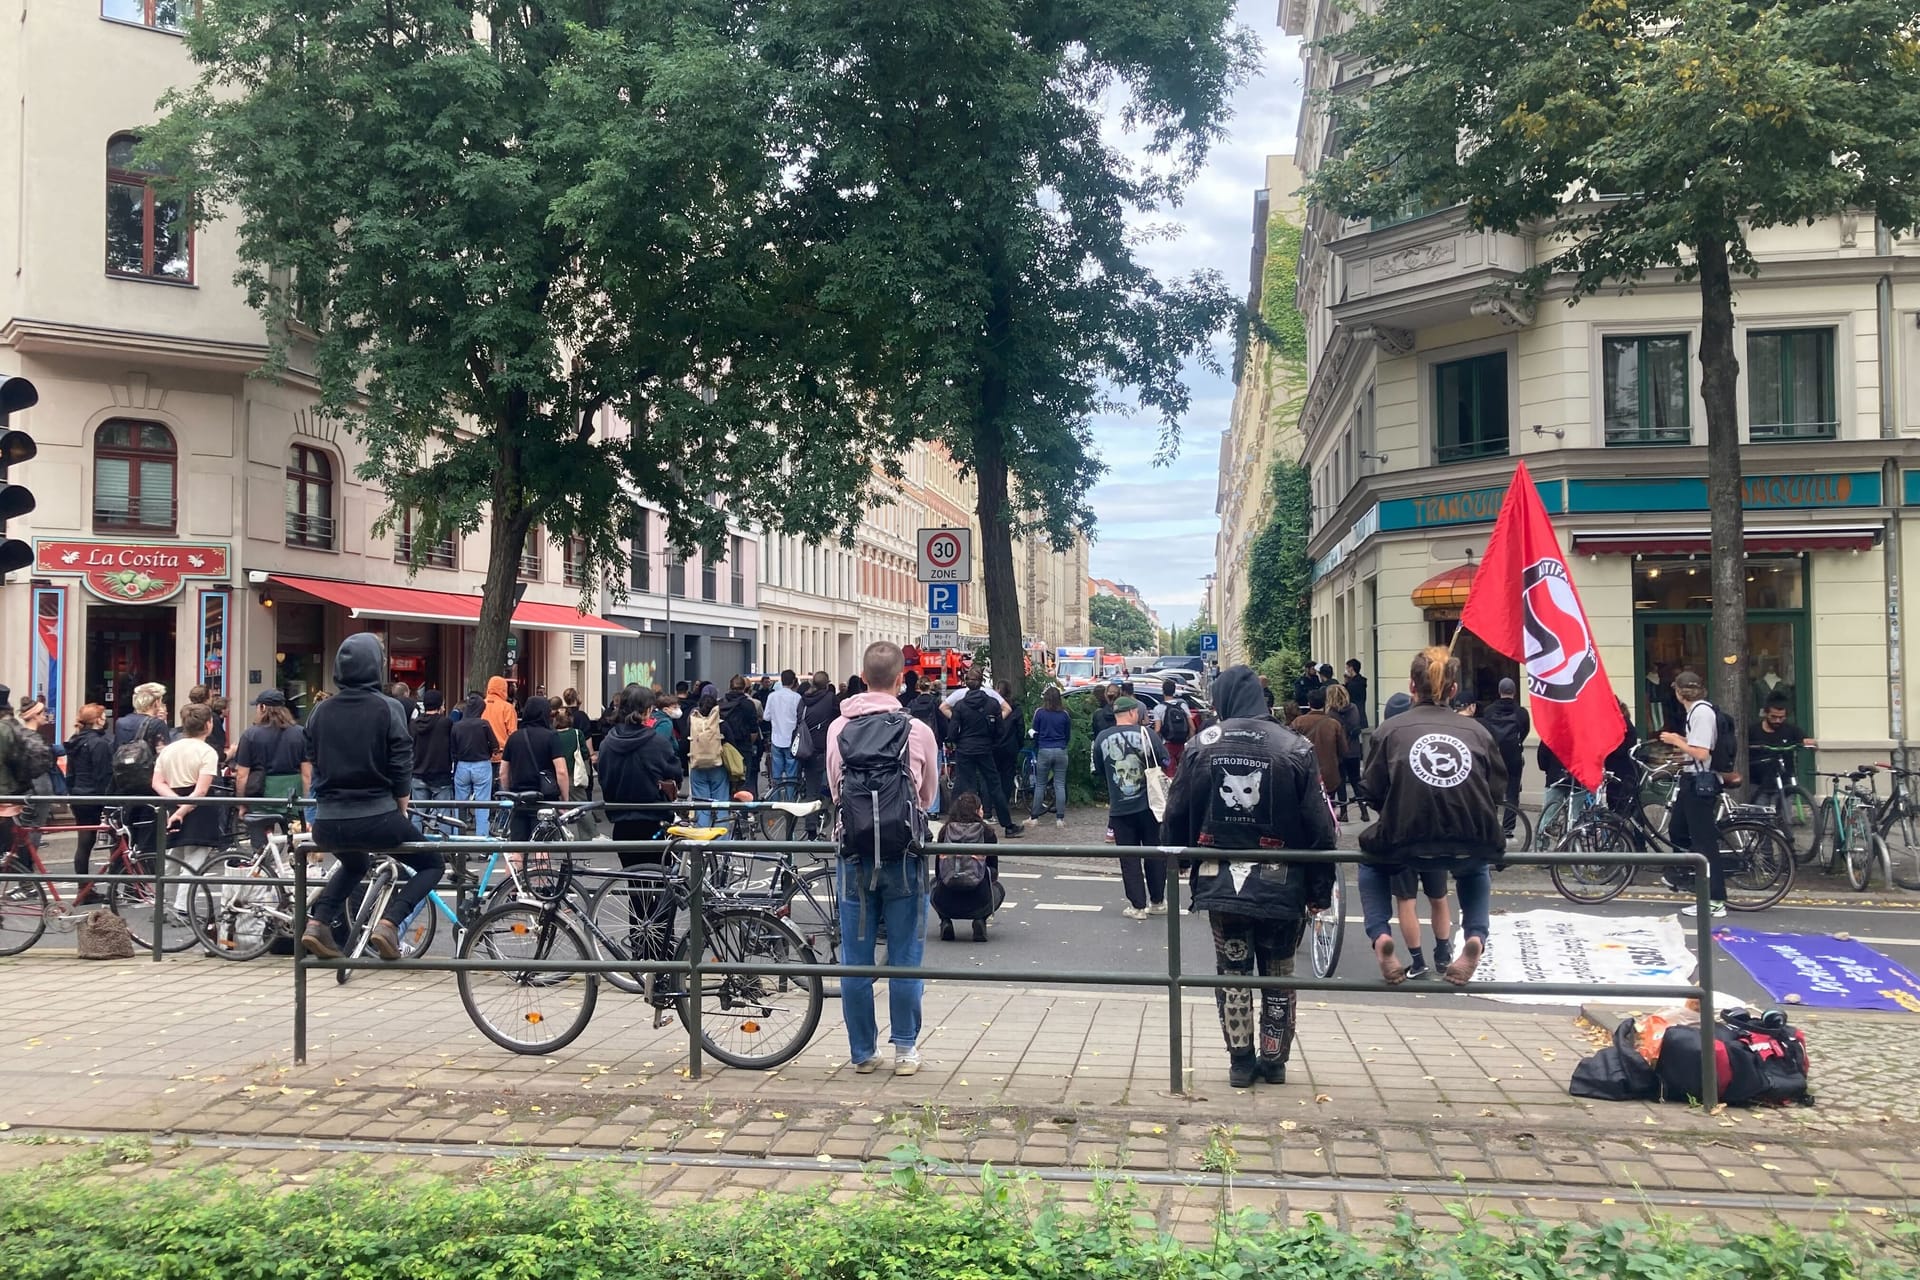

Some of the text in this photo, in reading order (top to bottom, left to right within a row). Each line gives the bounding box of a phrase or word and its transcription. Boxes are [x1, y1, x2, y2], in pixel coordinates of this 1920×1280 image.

[1702, 474, 1851, 505] TANQUILLO
[84, 548, 179, 567] La Cosita
[933, 542, 954, 558] 30
[930, 569, 957, 579] ZONE
[933, 587, 950, 611] P
[1203, 635, 1213, 650] P
[1412, 735, 1469, 756] GOOD NIGHT
[1212, 757, 1269, 769] STRONGBOW
[1414, 764, 1470, 786] WHITE PRIDE
